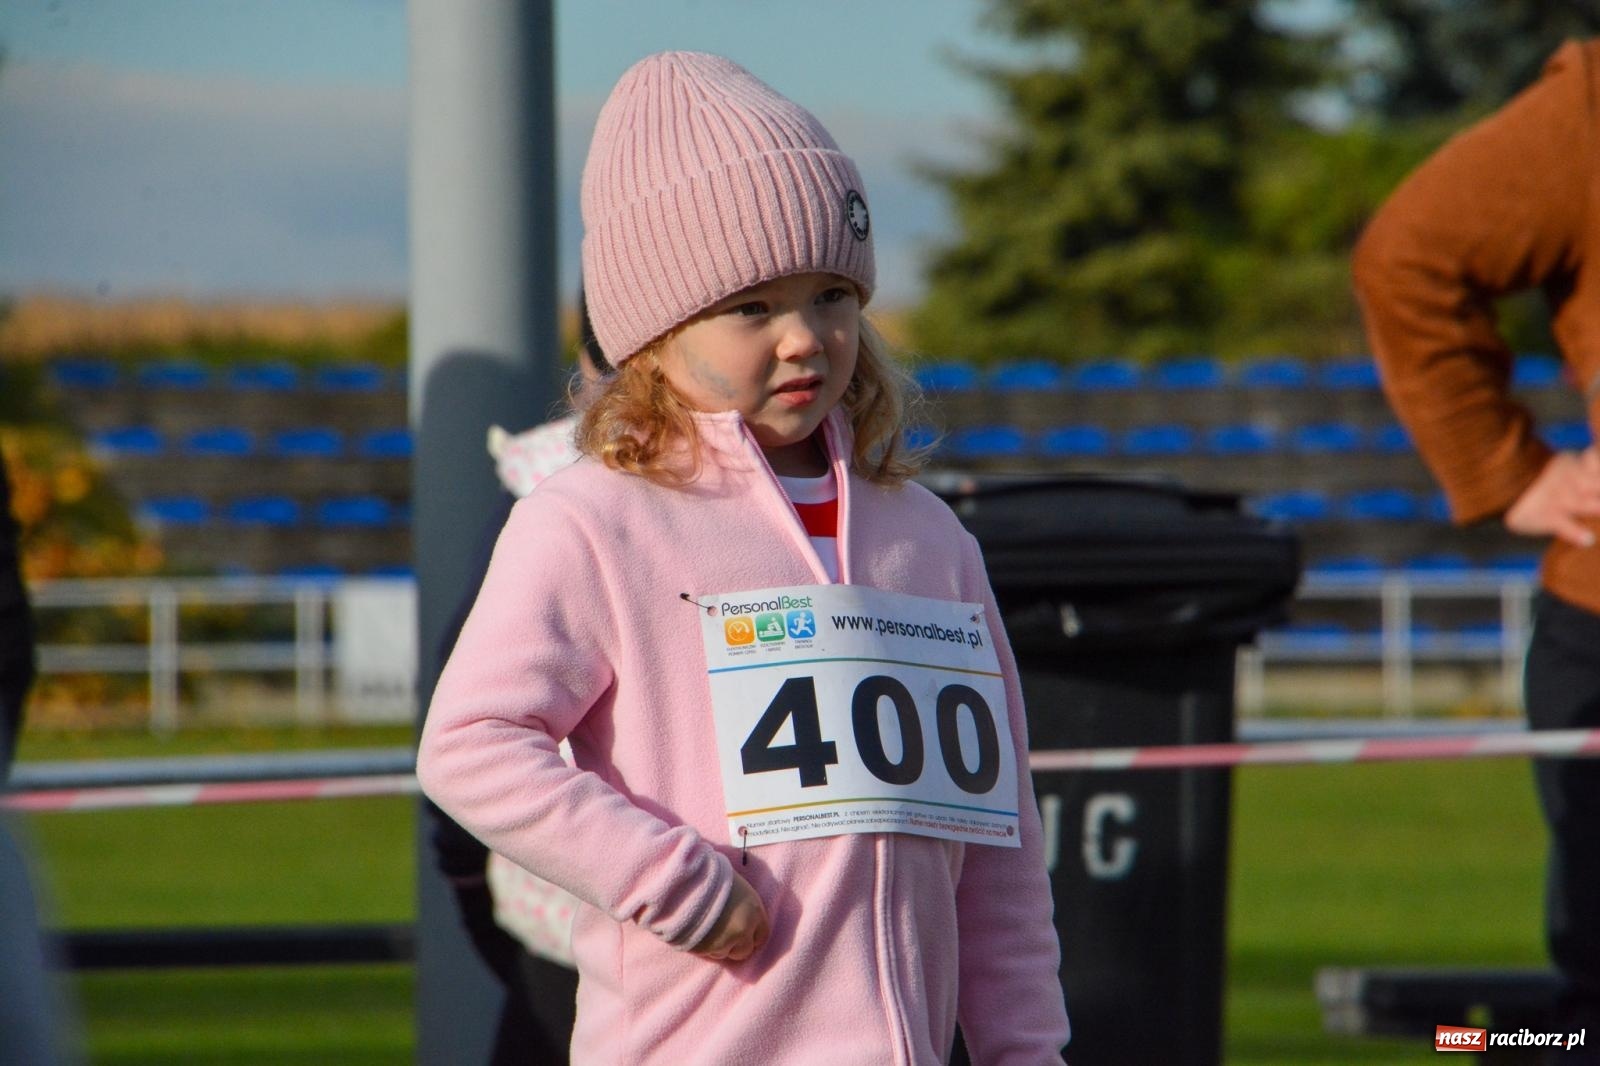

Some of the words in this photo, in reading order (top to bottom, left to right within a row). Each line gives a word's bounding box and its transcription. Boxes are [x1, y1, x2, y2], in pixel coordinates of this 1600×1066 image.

[721, 596, 814, 616] PersonalBest
[831, 615, 984, 648] www.personalbest.pl
[740, 675, 1000, 795] 400
